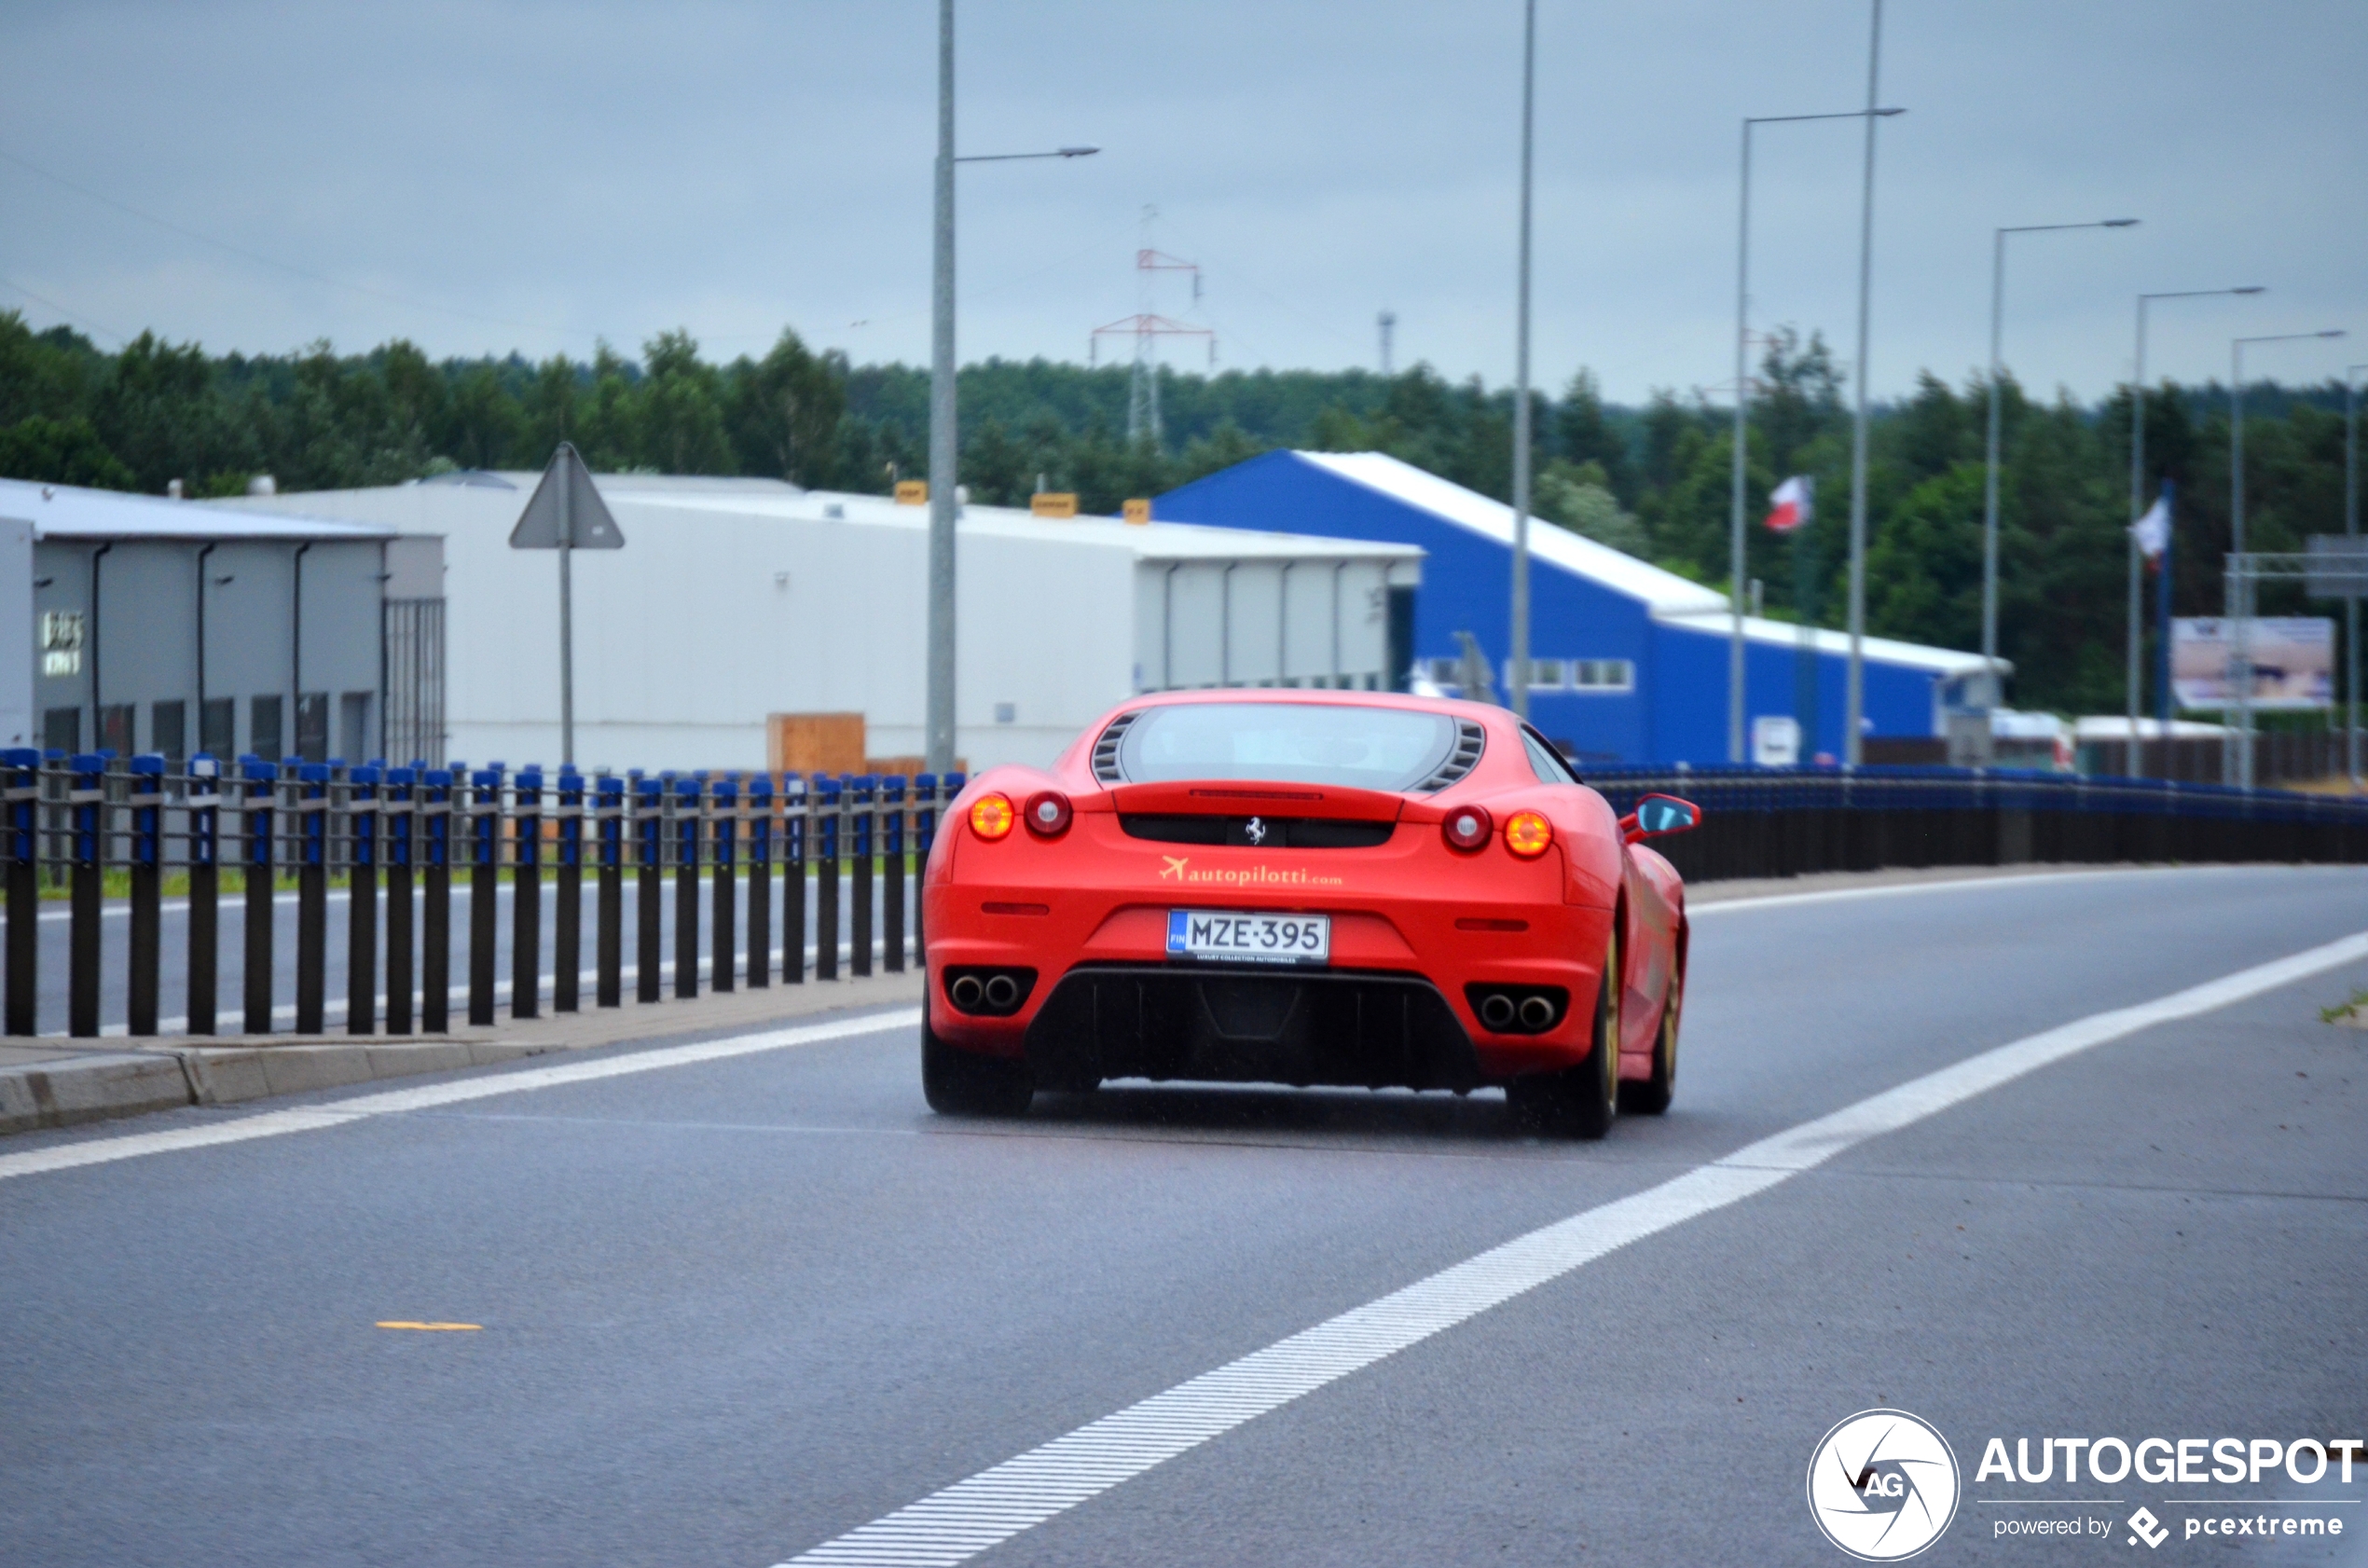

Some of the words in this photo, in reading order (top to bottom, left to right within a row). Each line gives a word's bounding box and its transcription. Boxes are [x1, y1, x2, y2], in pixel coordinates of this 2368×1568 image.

[1188, 865, 1342, 887] autopilotti.com
[1170, 934, 1186, 944] FIN
[1219, 955, 1255, 963] COLLECTION
[1256, 956, 1296, 964] AUTOMOBILES
